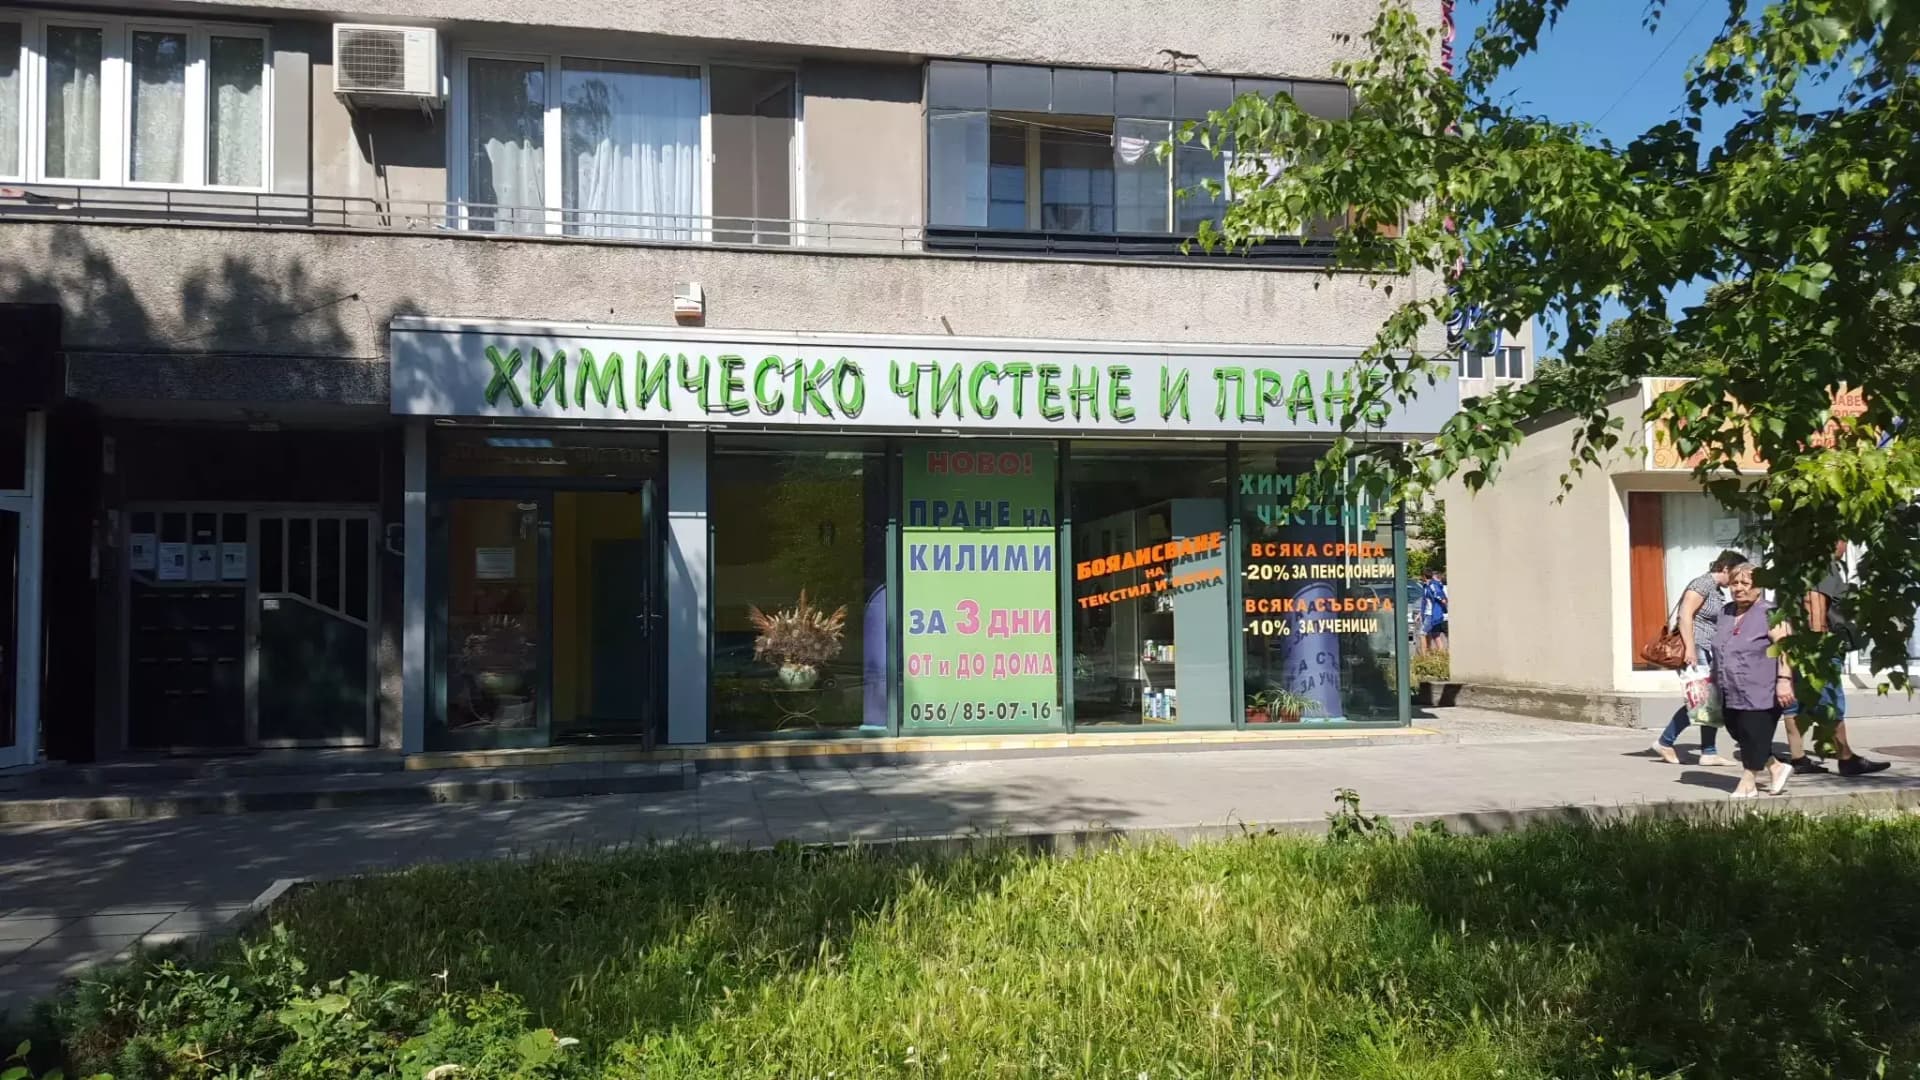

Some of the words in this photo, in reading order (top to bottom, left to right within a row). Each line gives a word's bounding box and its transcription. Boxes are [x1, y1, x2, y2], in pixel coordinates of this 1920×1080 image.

[484, 344, 866, 420] ХИМИЧЕСКО
[889, 359, 1136, 423] ЧИСТЕНЕ
[1159, 365, 1190, 423] И
[928, 452, 1033, 476] НОВО!
[908, 500, 1011, 527] ПРАНЕ
[909, 544, 1052, 572] КИЛИМИ
[1077, 531, 1221, 581] БОЯДИСВАНЕ
[1251, 543, 1317, 557] ВСЯКА
[1323, 543, 1385, 558] СРЯДА
[1144, 567, 1165, 579] НА
[1241, 564, 1290, 581] -20%
[1292, 564, 1307, 579] ЗА
[1311, 564, 1395, 579] ПЕНСИОНЕРИ
[1078, 583, 1151, 609] ТЕКСТИЛ
[1155, 579, 1168, 592] И
[1245, 599, 1308, 613] ВСЯКА
[1315, 598, 1393, 613] СЪБОТА
[908, 609, 947, 635] ЗА
[955, 599, 980, 636] 3
[987, 609, 1053, 638] ДНИ
[1242, 620, 1290, 635] -10%
[1299, 620, 1314, 634] ЗА
[1319, 619, 1377, 635] УЧЕНИЦИ
[908, 654, 932, 677] ОТ
[957, 654, 985, 679] ДО
[992, 654, 1054, 679] ДОМА
[910, 702, 1051, 727] 056/85-07-16
